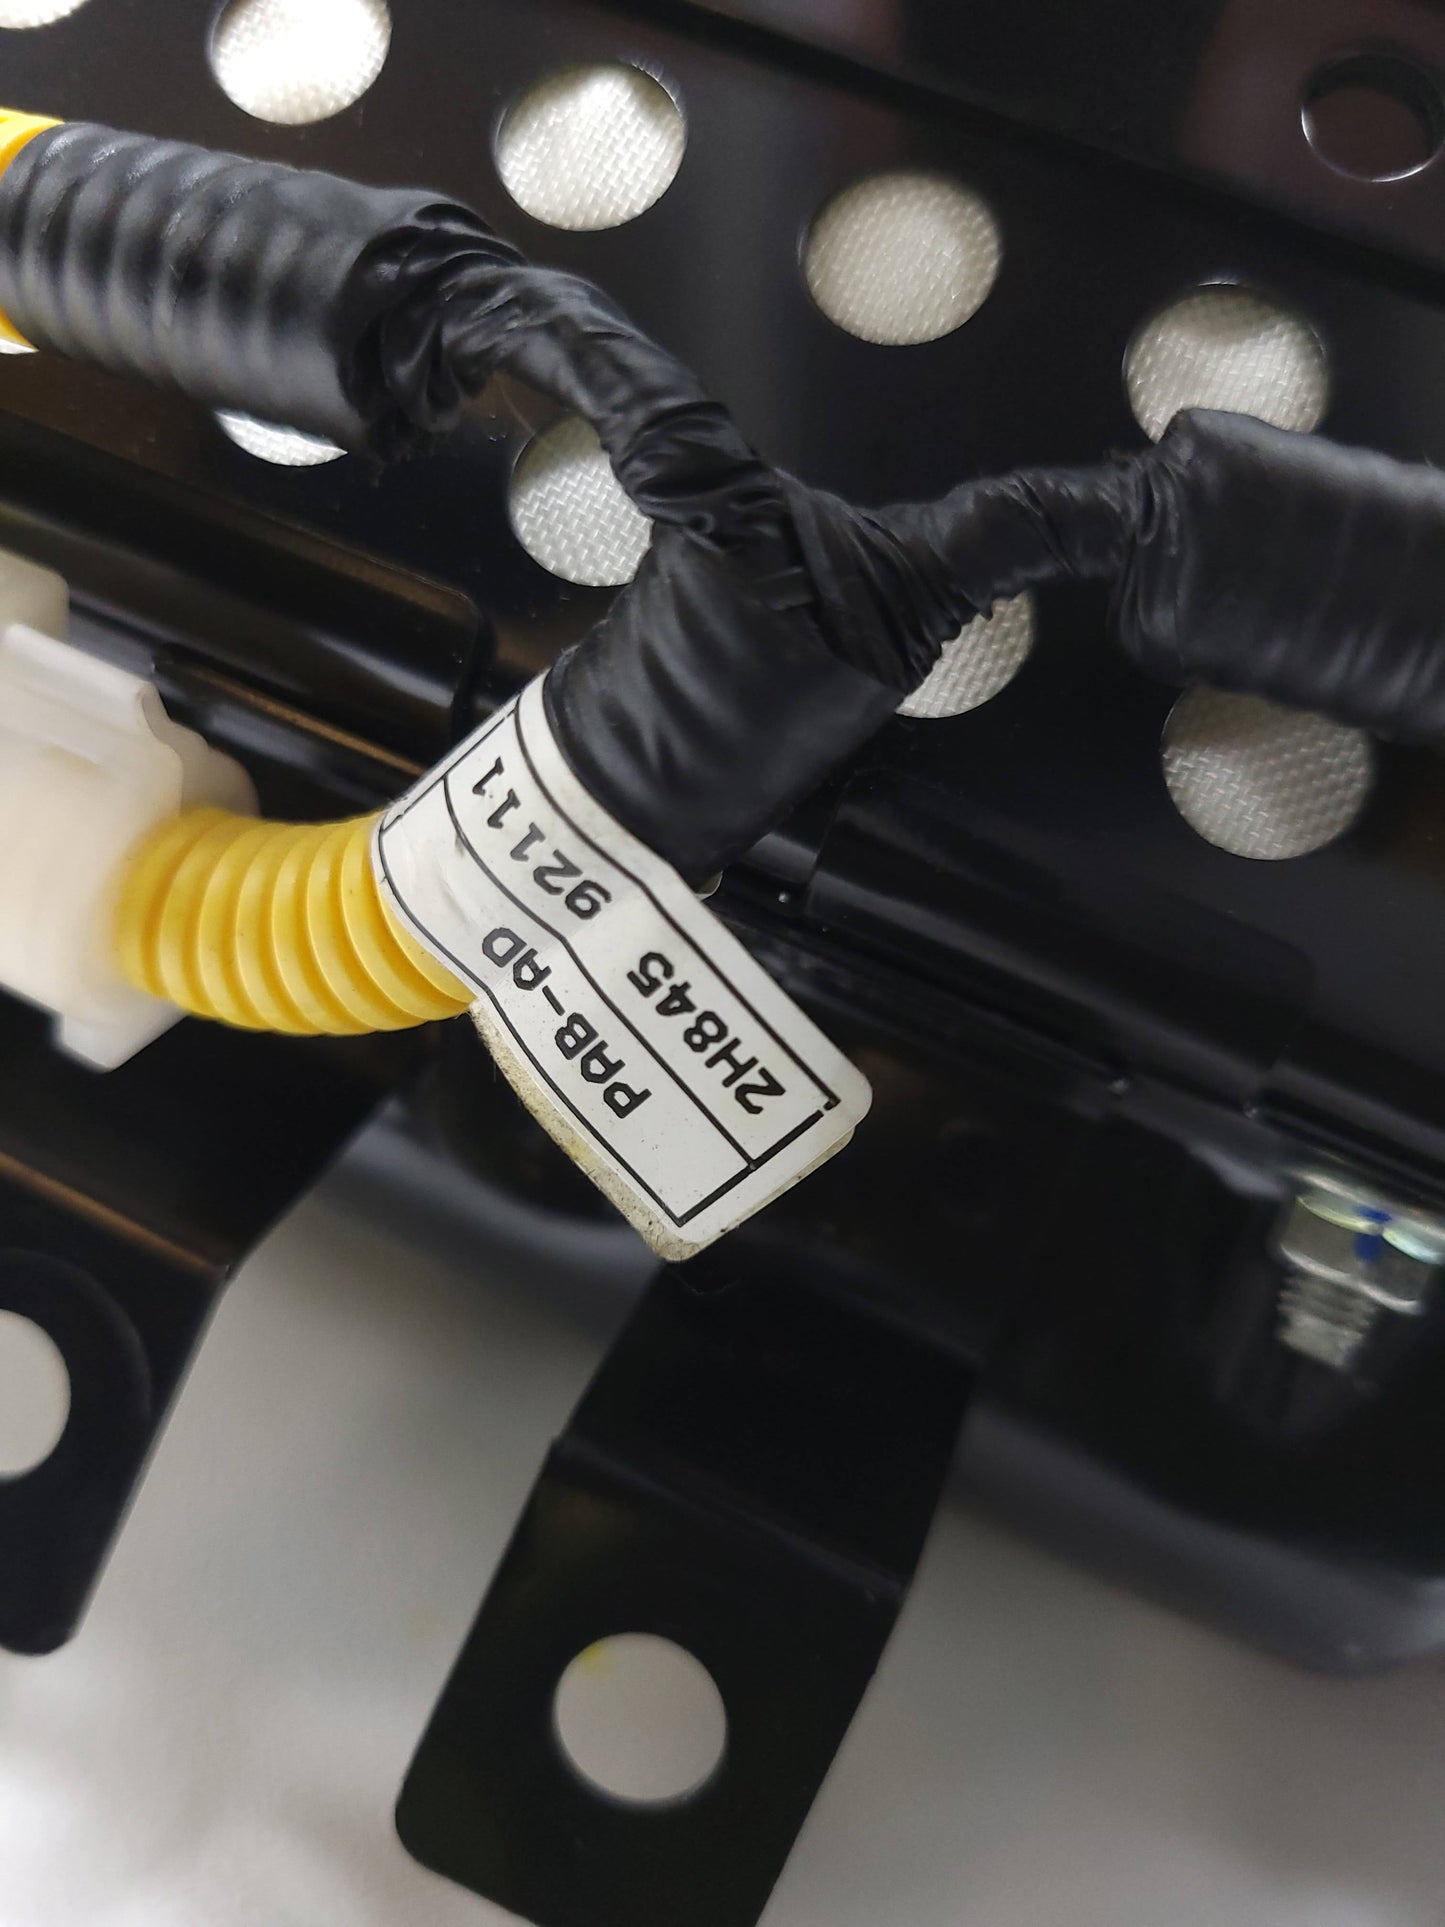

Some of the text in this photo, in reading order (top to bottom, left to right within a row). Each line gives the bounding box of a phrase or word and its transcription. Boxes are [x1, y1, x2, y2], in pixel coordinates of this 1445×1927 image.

[470, 755, 788, 1116] 2H845 92111
[481, 926, 653, 1120] PAB-AD
